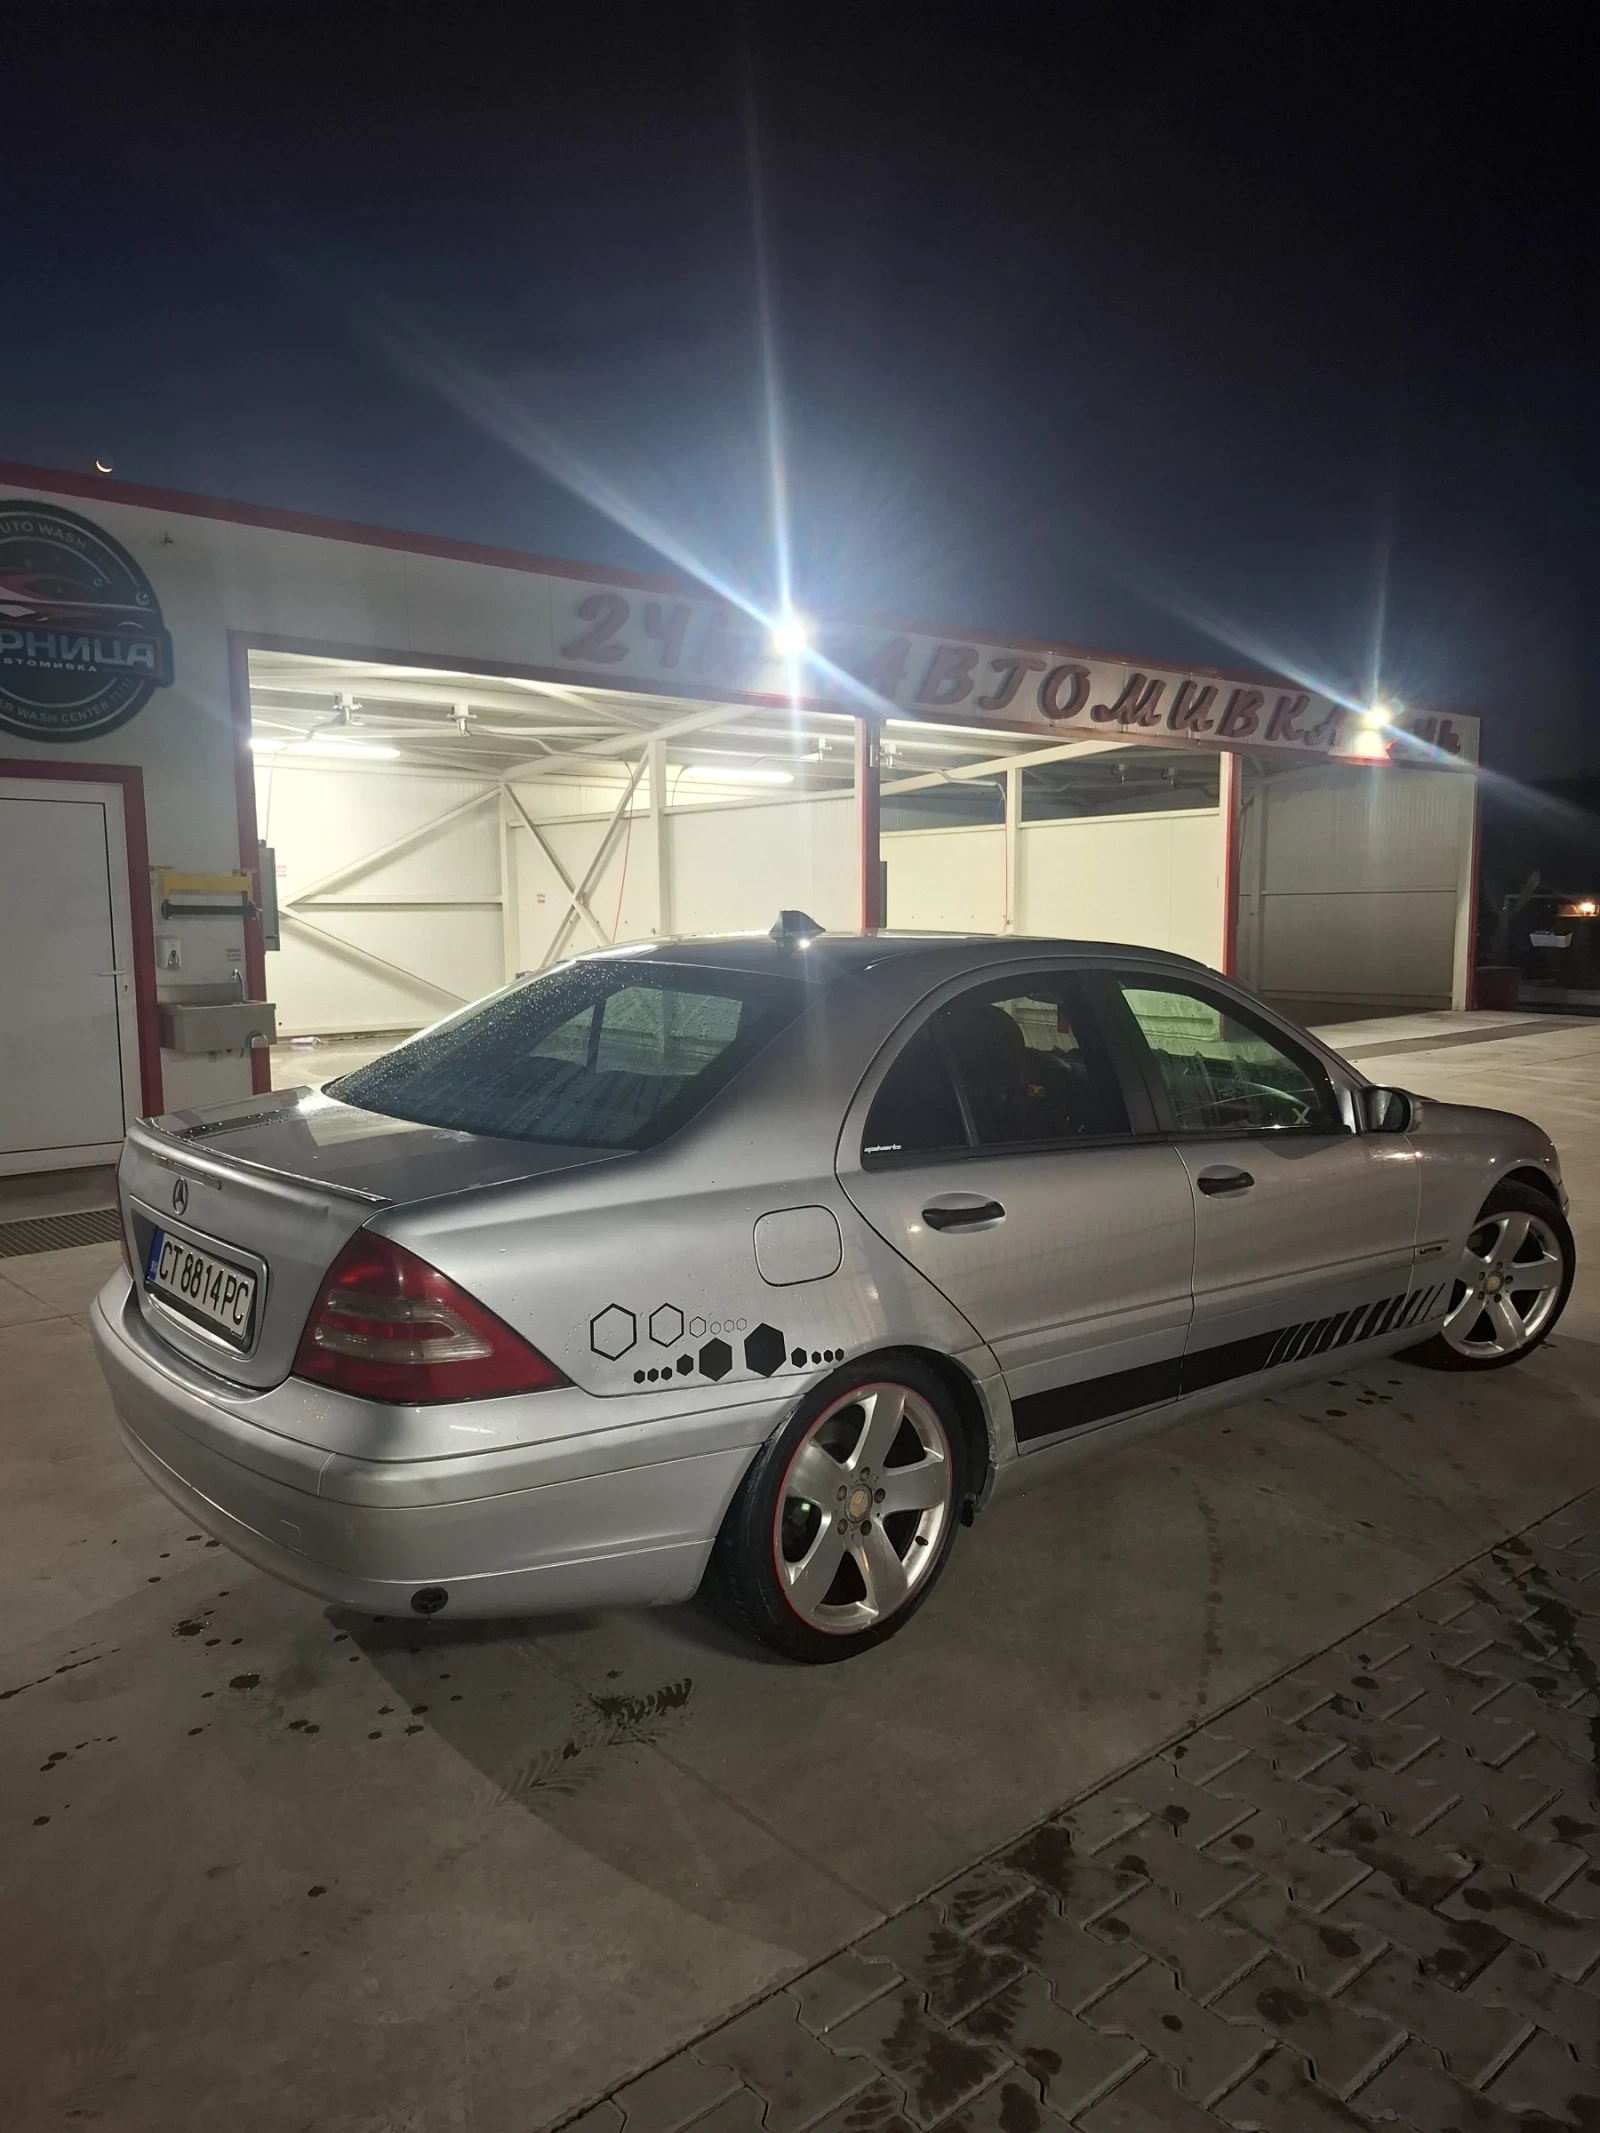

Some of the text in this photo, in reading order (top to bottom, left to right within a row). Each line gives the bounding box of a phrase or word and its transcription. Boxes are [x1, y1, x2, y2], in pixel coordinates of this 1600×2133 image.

[0, 521, 87, 550] UTO WASH
[0, 628, 155, 669] РНИЦА
[0, 656, 97, 672] ВТОМИВКА
[17, 706, 57, 723] WASH
[61, 701, 111, 723] CENTER
